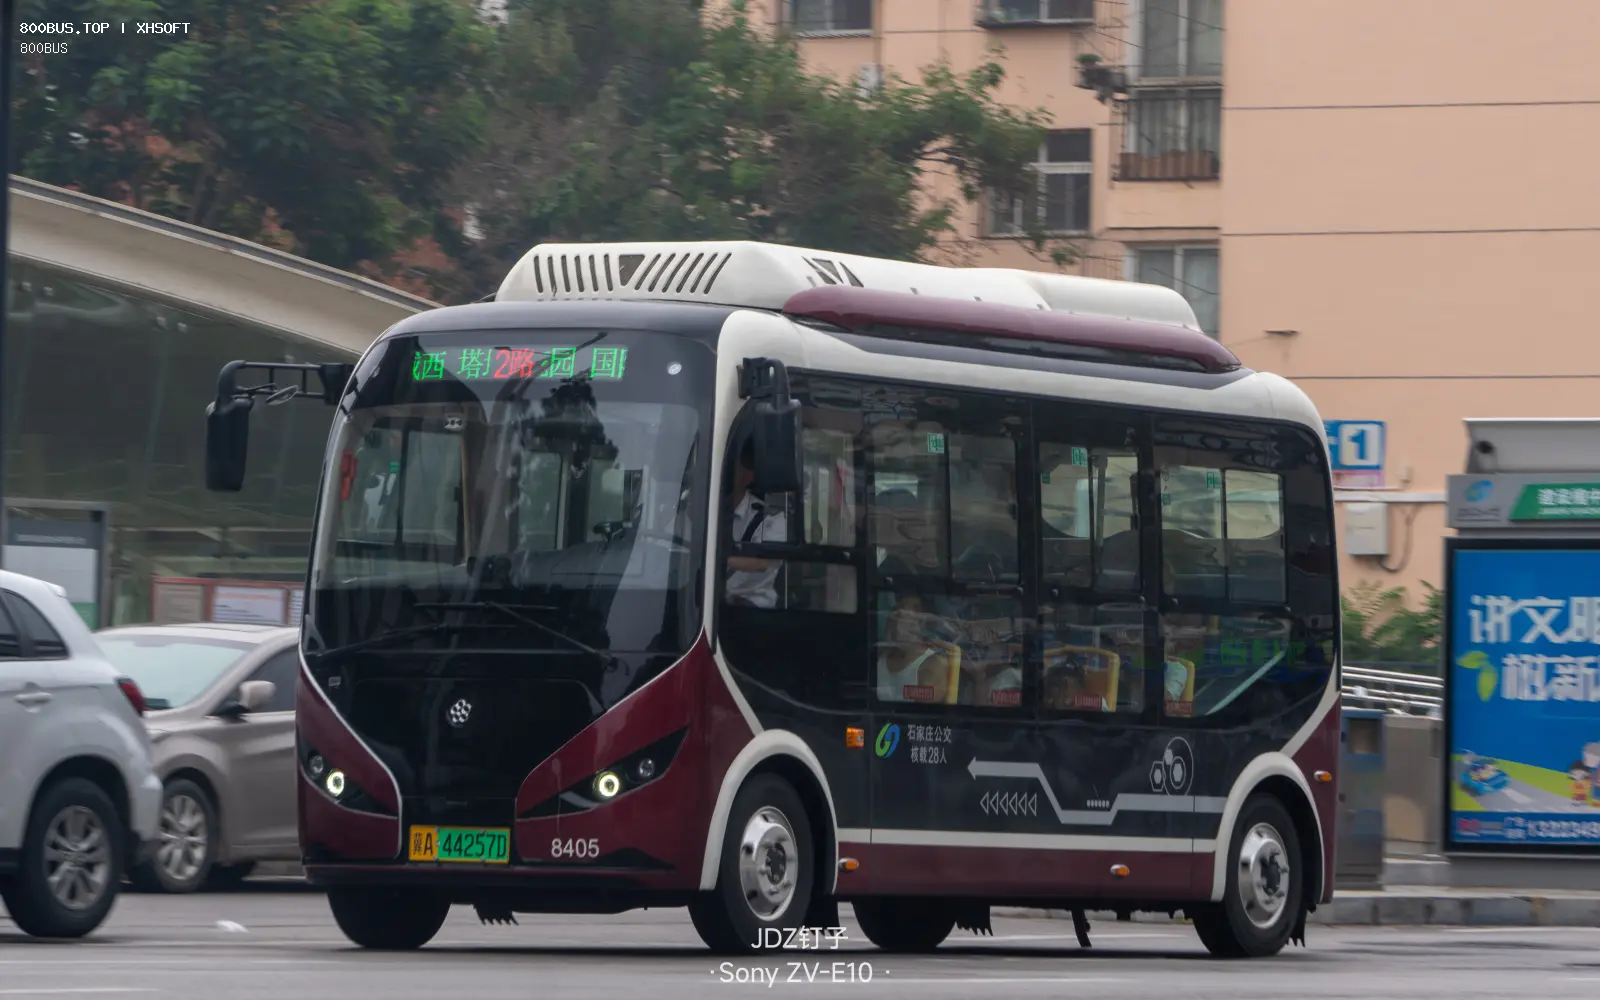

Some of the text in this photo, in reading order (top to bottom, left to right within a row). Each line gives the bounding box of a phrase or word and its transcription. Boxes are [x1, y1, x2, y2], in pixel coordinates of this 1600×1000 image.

[907, 723, 953, 744] 石家庄公交
[910, 744, 948, 765] 核载28人
[441, 833, 508, 860] 44257D
[551, 837, 600, 858] 8405
